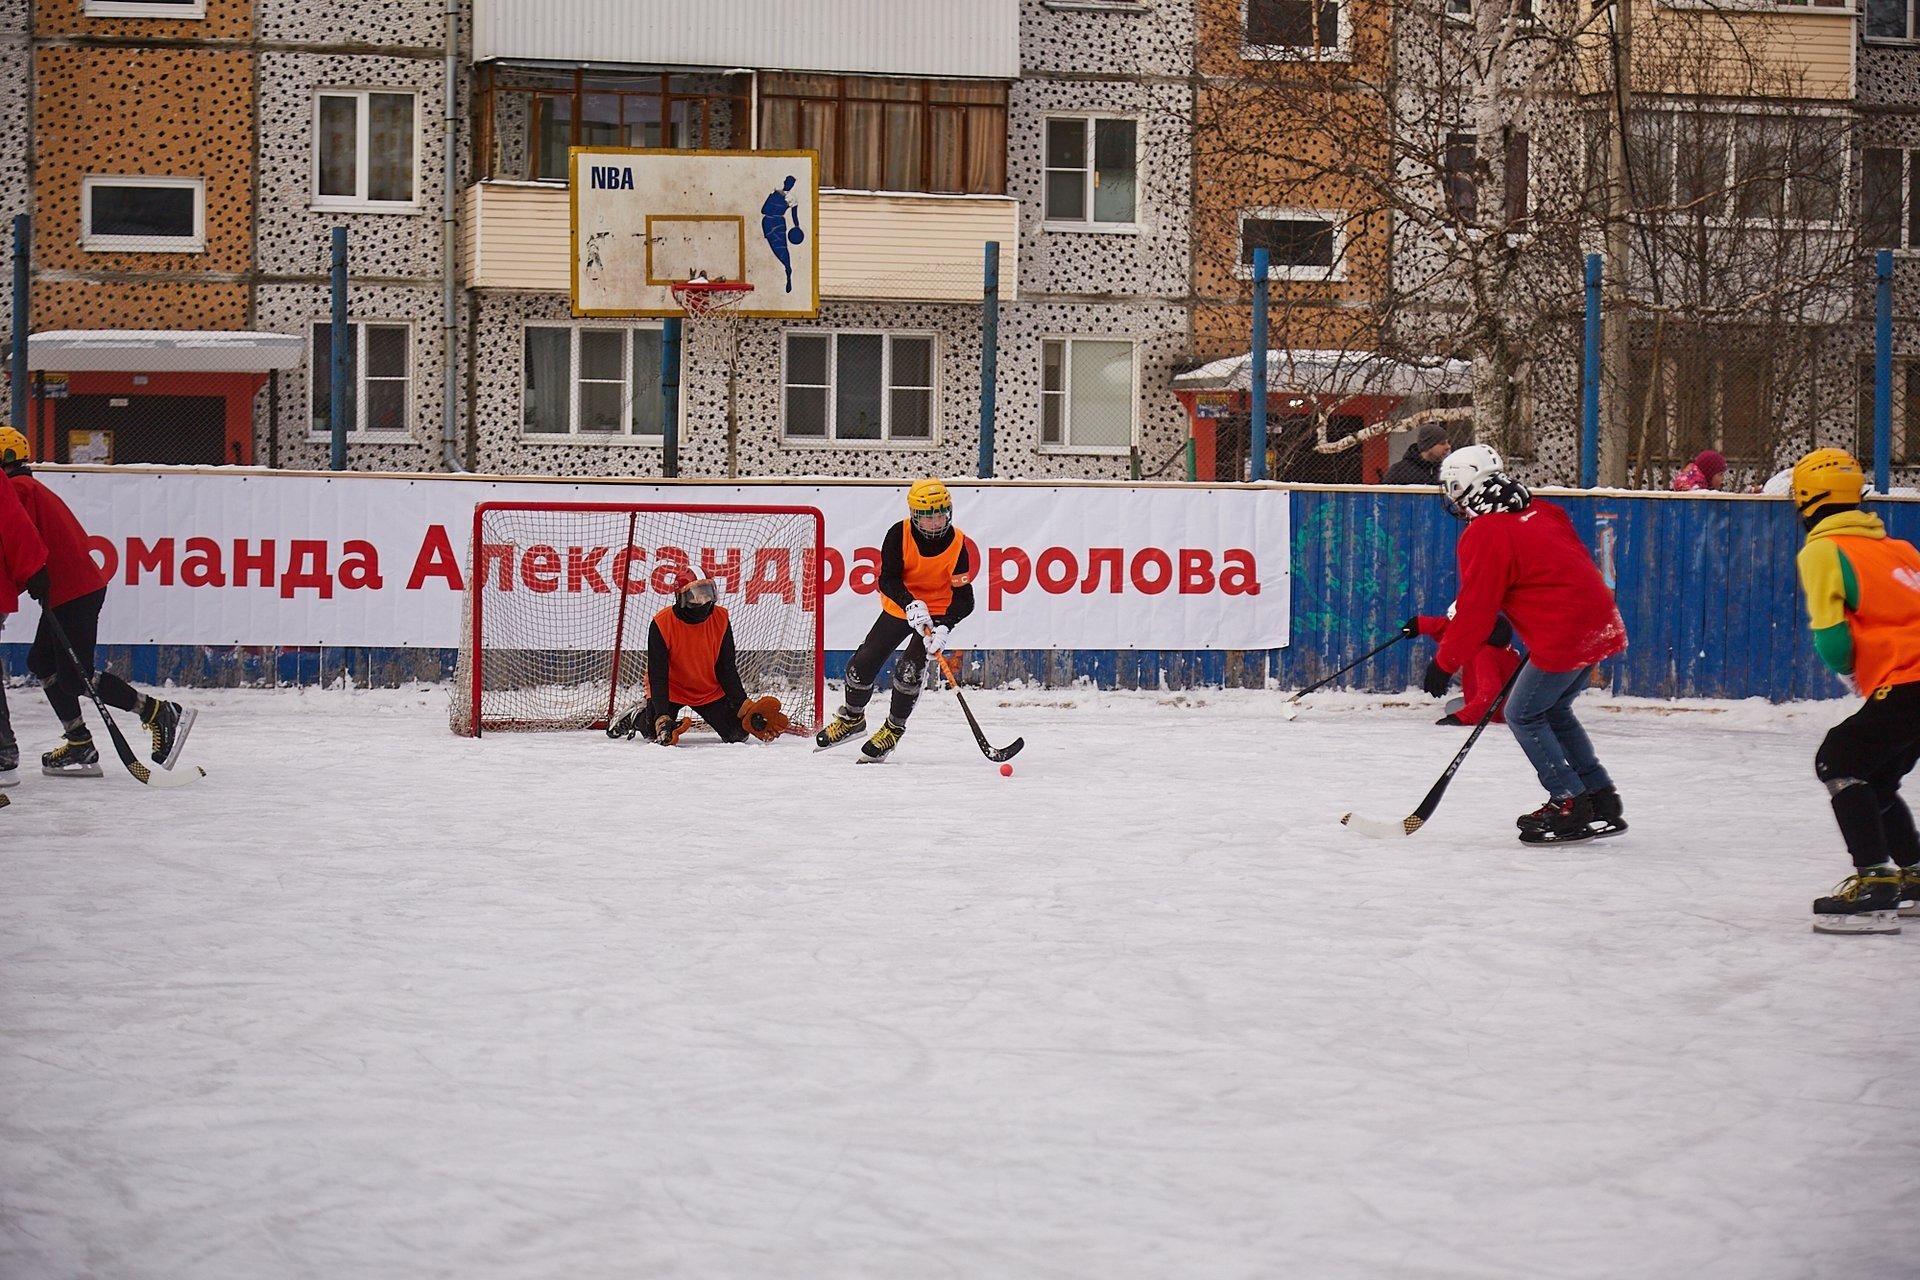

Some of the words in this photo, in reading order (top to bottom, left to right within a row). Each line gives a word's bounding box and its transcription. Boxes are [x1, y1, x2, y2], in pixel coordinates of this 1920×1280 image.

[591, 166, 634, 190] NBA
[88, 536, 383, 599] оманда
[1446, 745, 1470, 778] STEX
